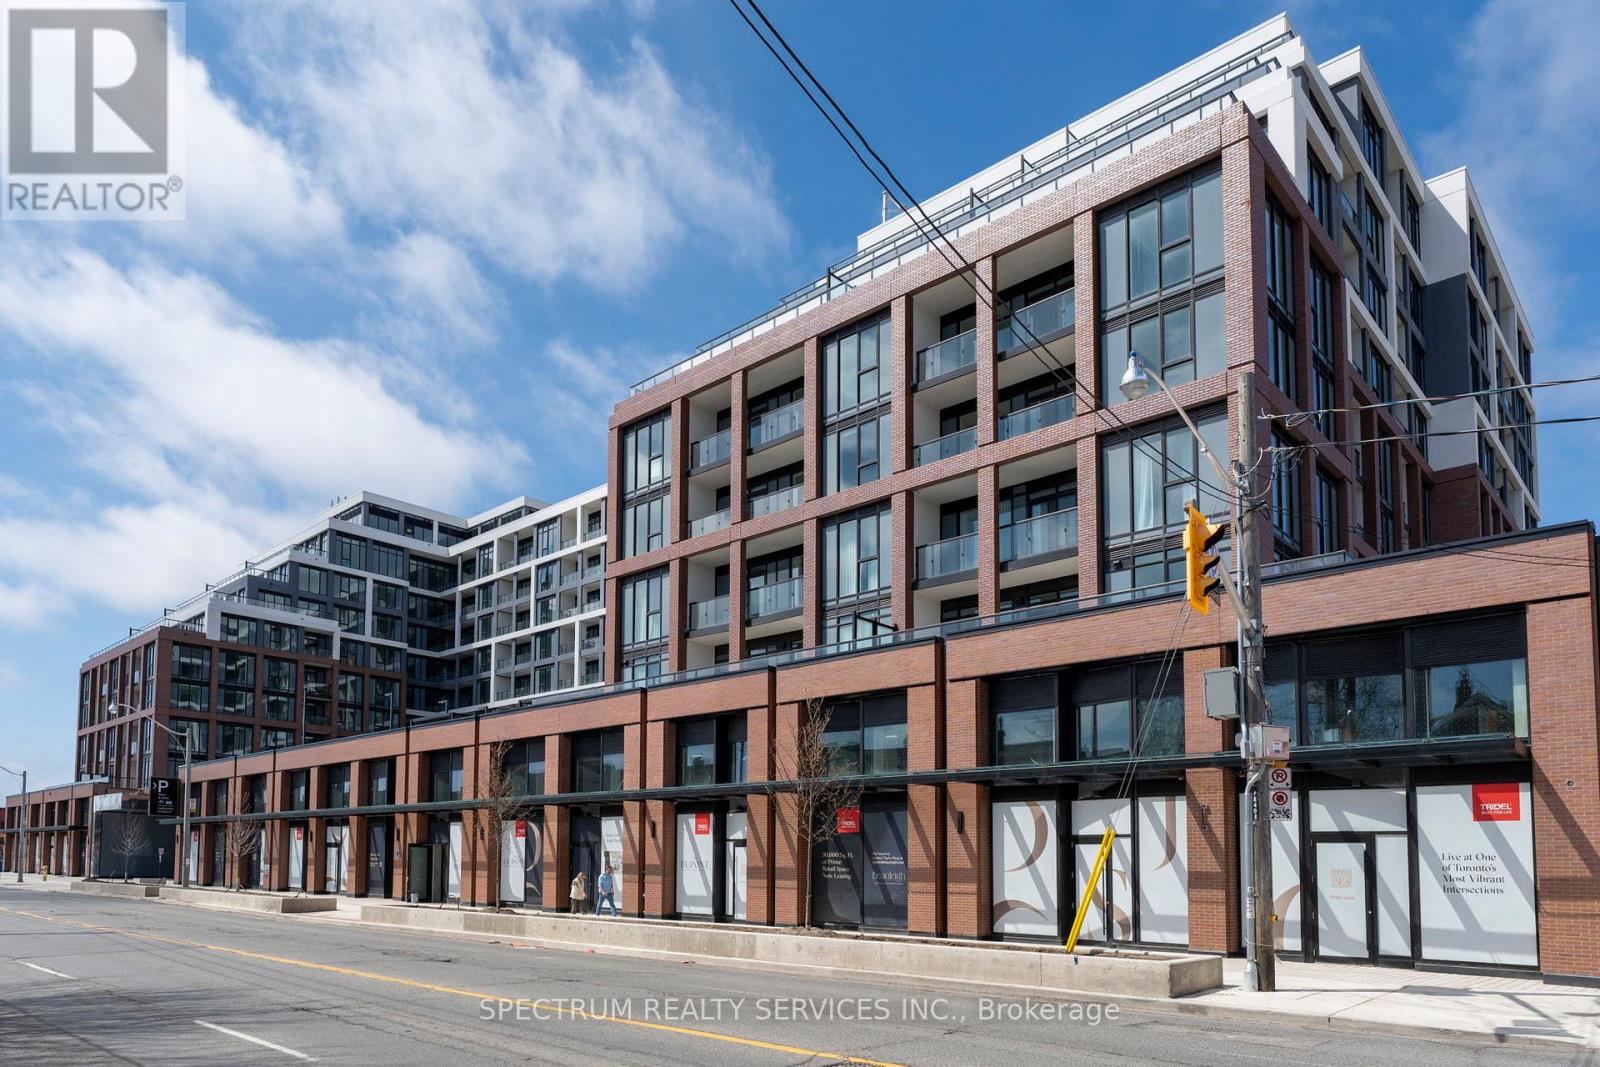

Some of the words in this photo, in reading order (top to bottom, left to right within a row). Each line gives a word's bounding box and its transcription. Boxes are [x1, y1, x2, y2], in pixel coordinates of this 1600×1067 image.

[1442, 852, 1462, 861] Live
[1463, 853, 1473, 861] at
[1475, 853, 1497, 861] One
[1441, 863, 1452, 872] of
[1454, 863, 1497, 872] Toronto's
[1443, 874, 1466, 883] Most
[1468, 874, 1505, 884] Vibrant
[1443, 885, 1505, 894] Intersections
